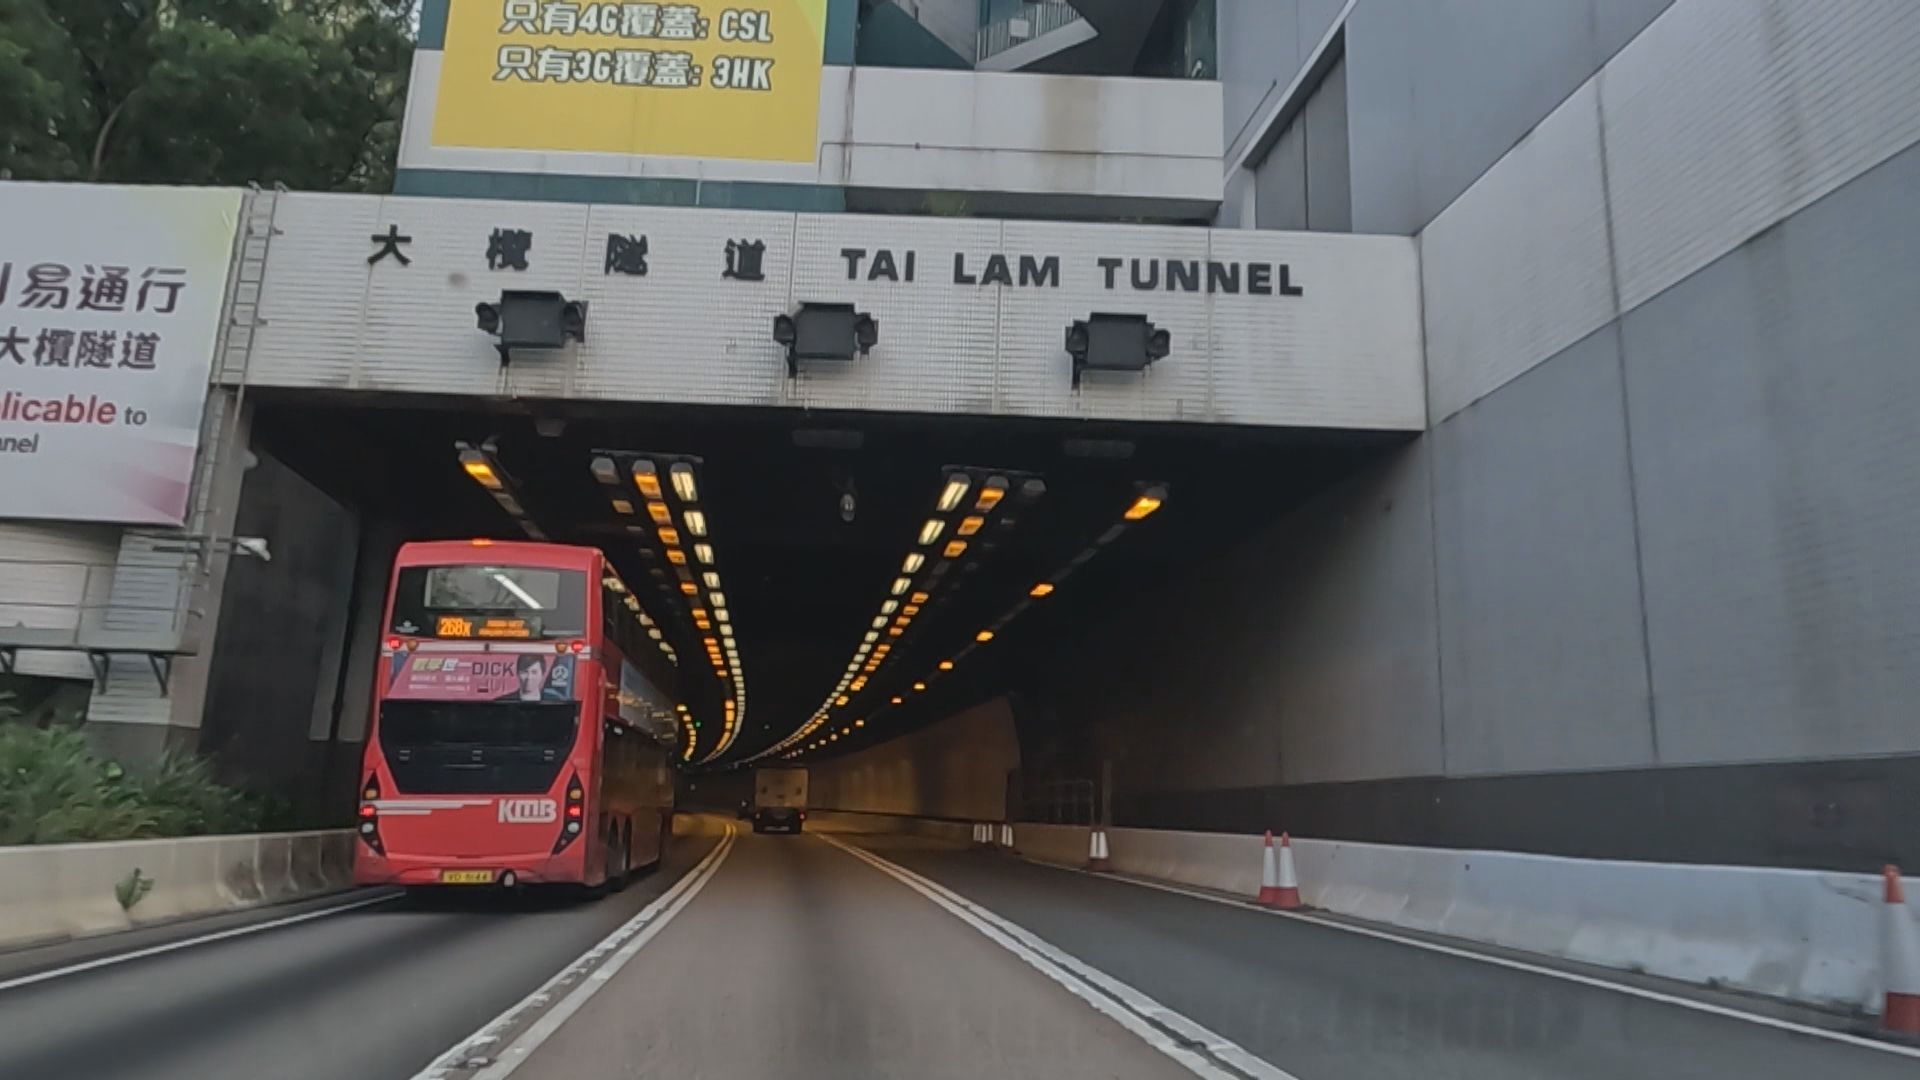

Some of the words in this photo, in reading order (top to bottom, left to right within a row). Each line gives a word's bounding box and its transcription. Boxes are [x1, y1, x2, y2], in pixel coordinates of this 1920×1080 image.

[719, 9, 773, 42] CSL
[493, 45, 702, 87] 只有3G覆蓋:
[711, 55, 775, 91] 3HK
[840, 247, 915, 282] TAI
[953, 252, 1060, 287] LAM
[1097, 257, 1303, 296] TUNNEL
[0, 391, 117, 424] licable
[124, 406, 147, 425] to
[472, 661, 515, 677] DICK
[497, 798, 557, 823] KMB
